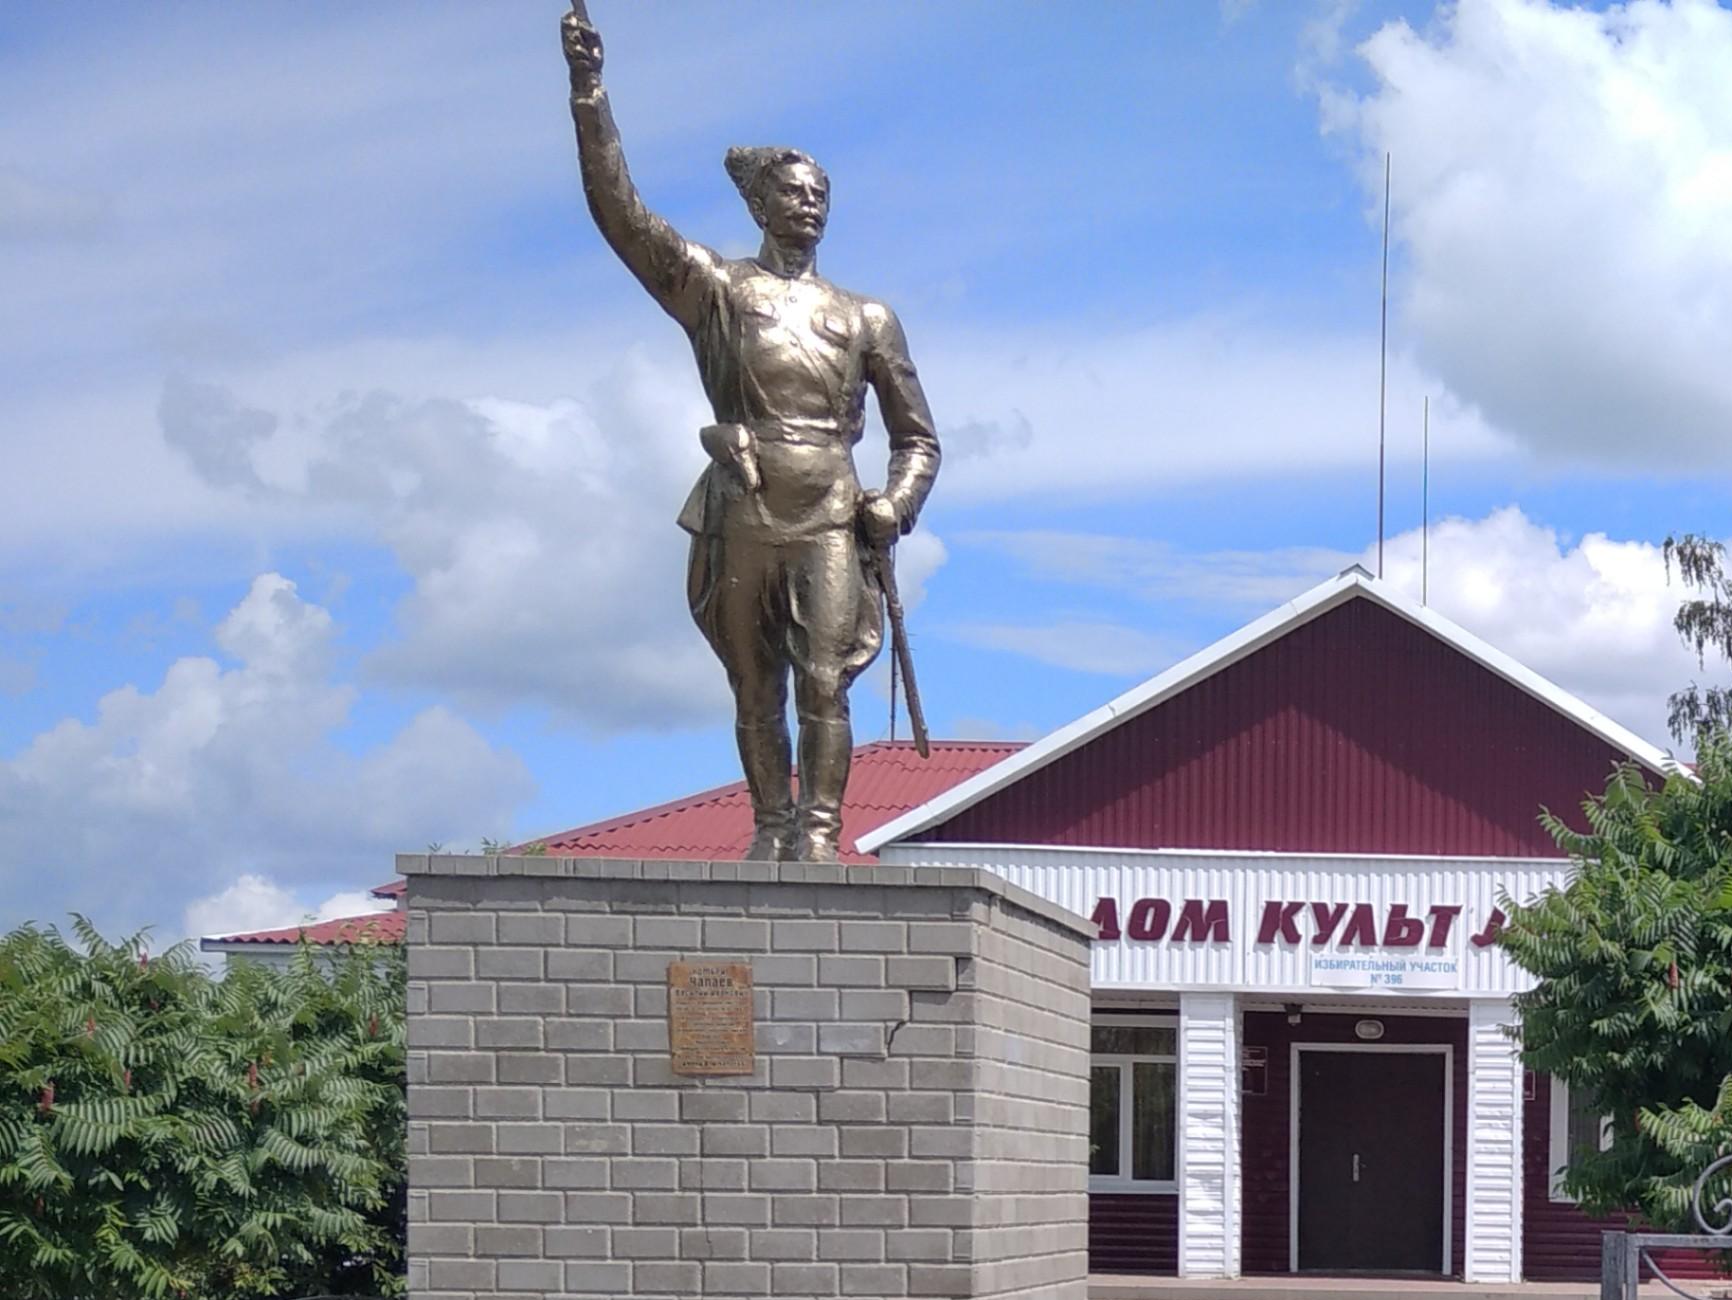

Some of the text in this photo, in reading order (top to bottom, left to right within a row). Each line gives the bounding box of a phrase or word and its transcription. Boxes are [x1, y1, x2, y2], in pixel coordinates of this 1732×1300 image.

[1089, 896, 1232, 943] ДОМ
[1314, 958, 1458, 973] ИЗБИРАТЕЛЬНЫЙ УЧАСТОК
